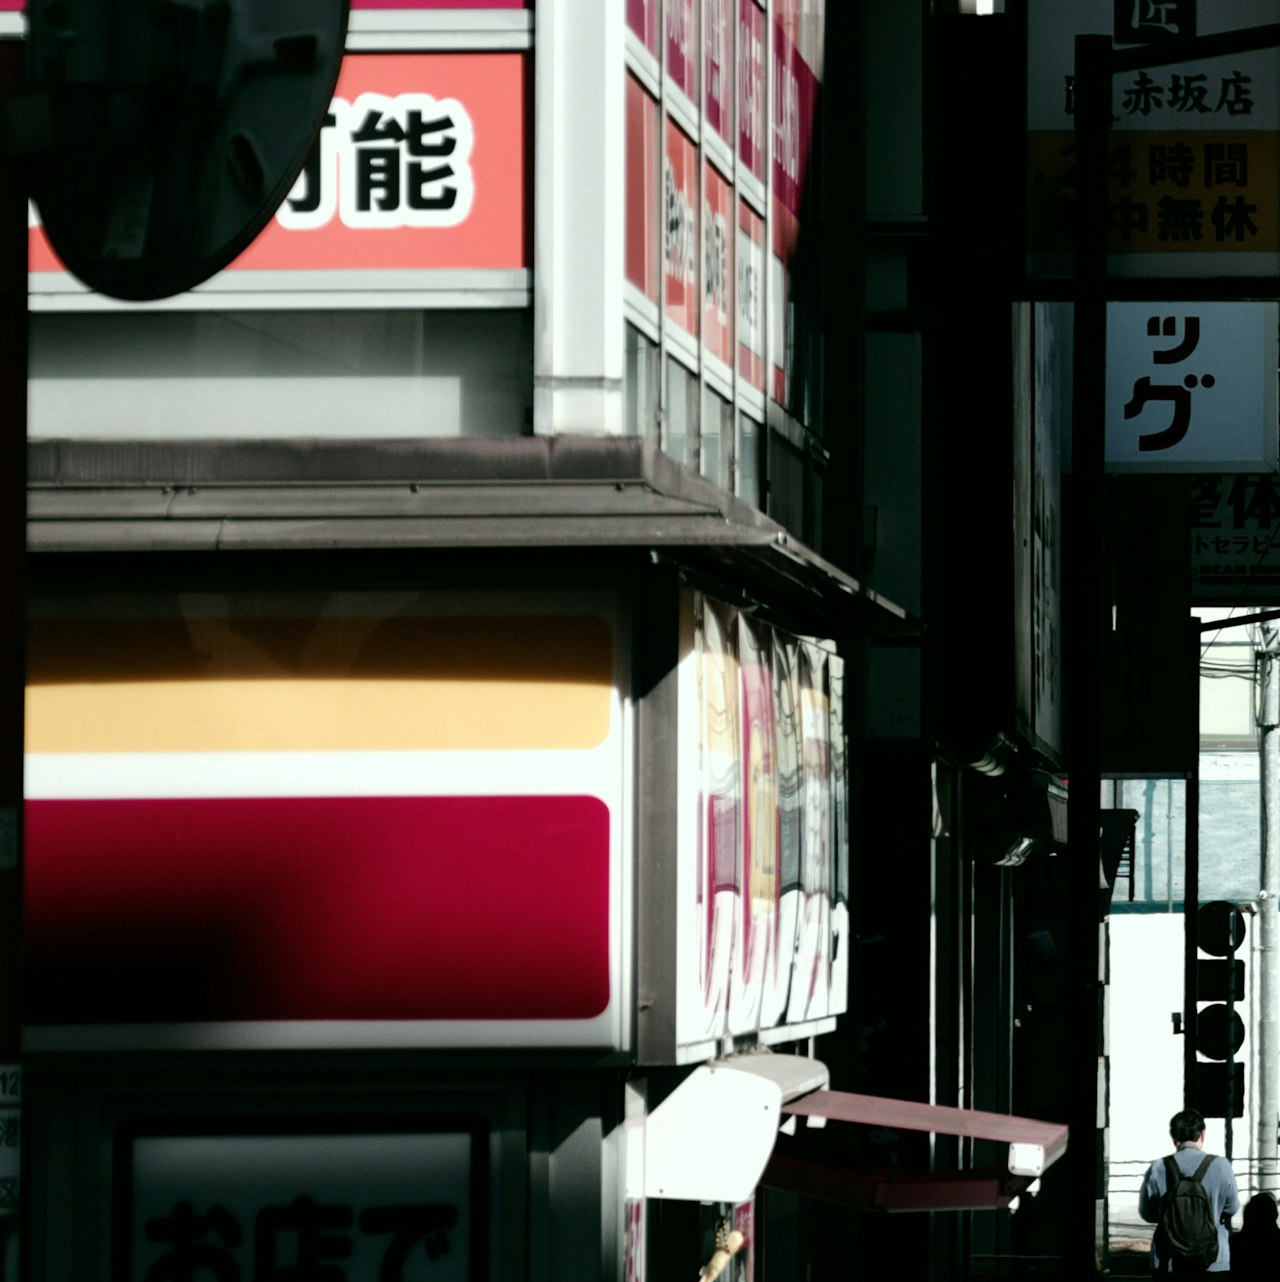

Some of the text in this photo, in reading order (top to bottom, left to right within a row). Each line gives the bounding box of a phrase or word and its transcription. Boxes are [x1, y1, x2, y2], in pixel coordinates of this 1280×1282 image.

[1122, 70, 1254, 116] 赤坂店
[1058, 195, 1258, 242] 中無休
